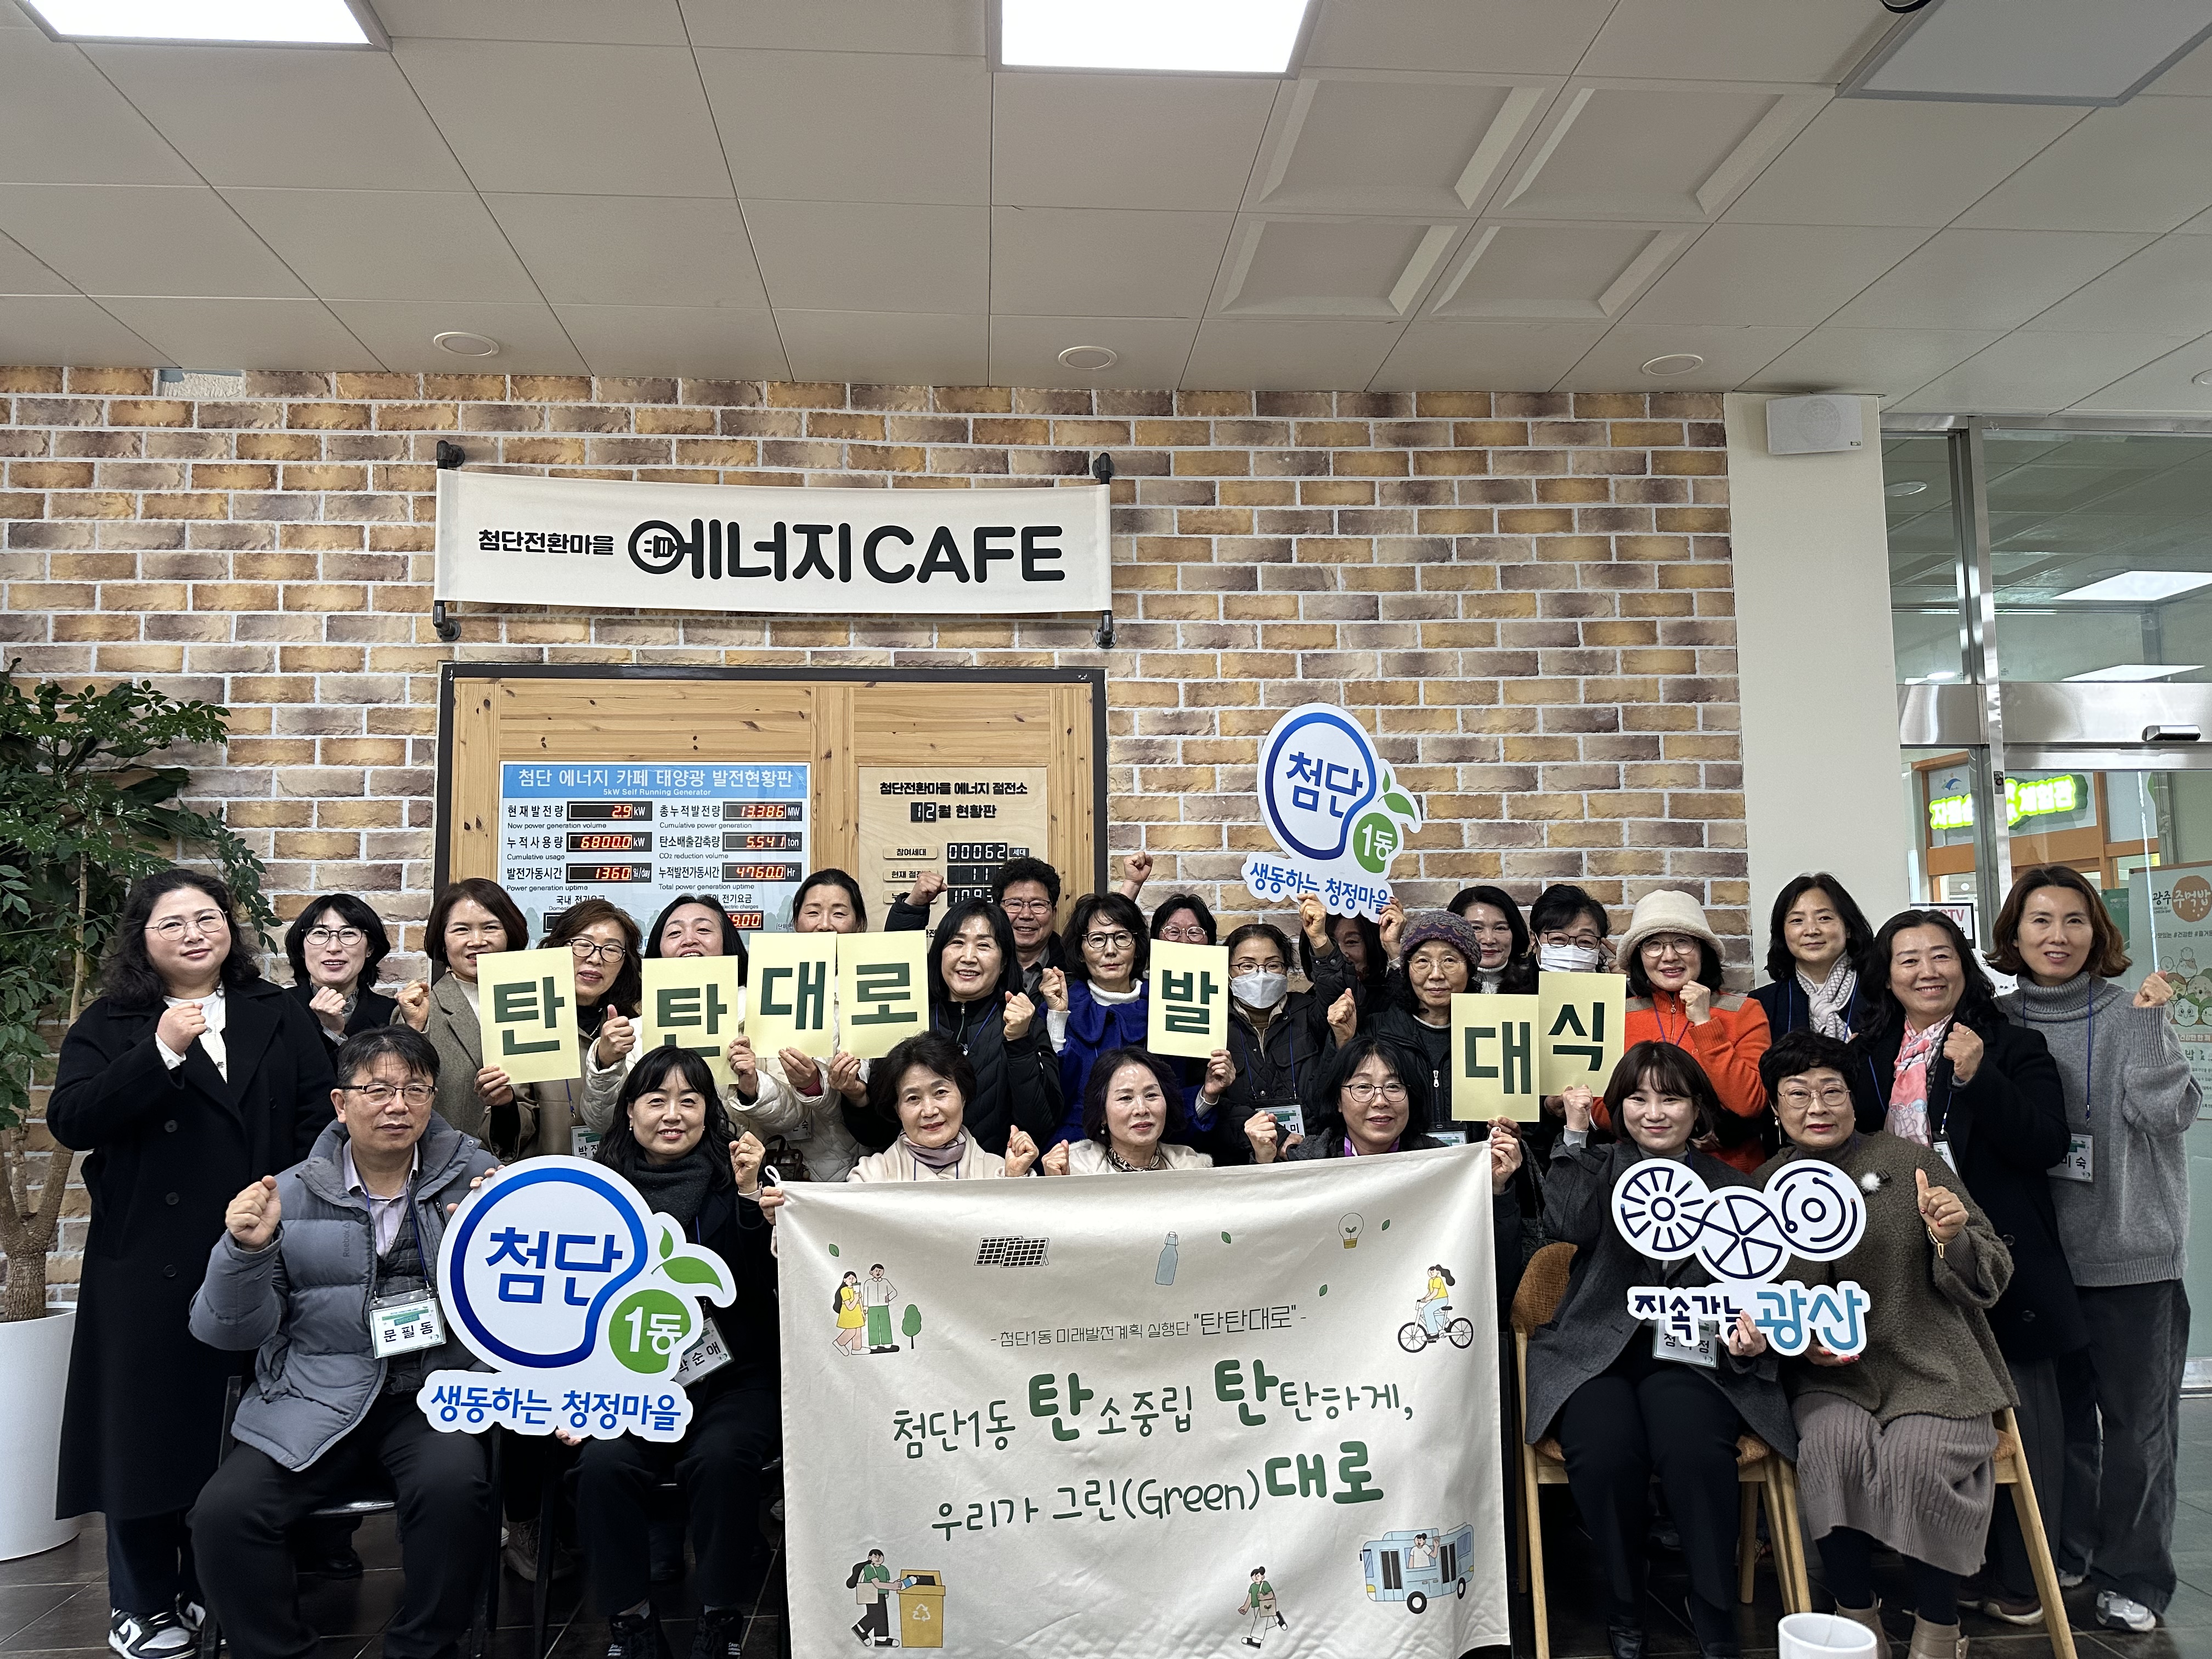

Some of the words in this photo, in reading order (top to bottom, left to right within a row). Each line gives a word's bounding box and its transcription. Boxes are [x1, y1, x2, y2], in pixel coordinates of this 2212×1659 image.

[478, 529, 613, 556] 첨단전환마을
[519, 769, 552, 787] 첨단
[559, 769, 608, 787] 에너지
[617, 769, 648, 787] 카페
[657, 770, 705, 787] 태양광
[713, 770, 793, 787] 발전현황판
[1286, 752, 1363, 818] 첨단
[879, 782, 951, 795] 첨단전환마을
[955, 782, 989, 795] 에너지
[992, 782, 1028, 795] 절전소
[507, 805, 563, 817] 현재발전량
[634, 806, 646, 816] kW
[659, 805, 720, 817] 총누적발전량
[787, 807, 800, 816] MW
[956, 804, 997, 818] 현황판
[507, 836, 563, 849] 누적사용량
[633, 837, 645, 847] kW
[659, 836, 720, 848] 탄소배출감축량
[788, 838, 799, 847] ton
[1362, 823, 1393, 861] 1동
[896, 848, 927, 856] 참여세대
[949, 845, 1006, 859] 00062
[1012, 848, 1026, 856] 세대
[507, 867, 562, 880] 발전가동시간
[659, 866, 719, 879] 누적발전가동시간
[787, 868, 795, 877] Hr
[891, 870, 906, 878] 현재
[1250, 862, 1320, 895] 생동하는
[1324, 877, 1391, 914] 청정마을
[556, 895, 571, 905] 국내
[722, 894, 752, 904] 전기요금
[2152, 890, 2171, 905] 광주
[1161, 970, 1218, 1034] 발
[486, 1227, 623, 1306] 첨단
[1634, 1295, 1743, 1342] 지속가능
[1756, 1289, 1862, 1350] 광산
[625, 1307, 682, 1355] 1동
[1057, 1323, 1143, 1343] 미래발전계획
[1148, 1321, 1190, 1339] 실행단
[431, 1386, 552, 1425] 생동하는
[561, 1390, 681, 1432] 청정마을
[893, 1400, 1016, 1459] 첨단1동
[932, 1495, 1039, 1542] 우리가
